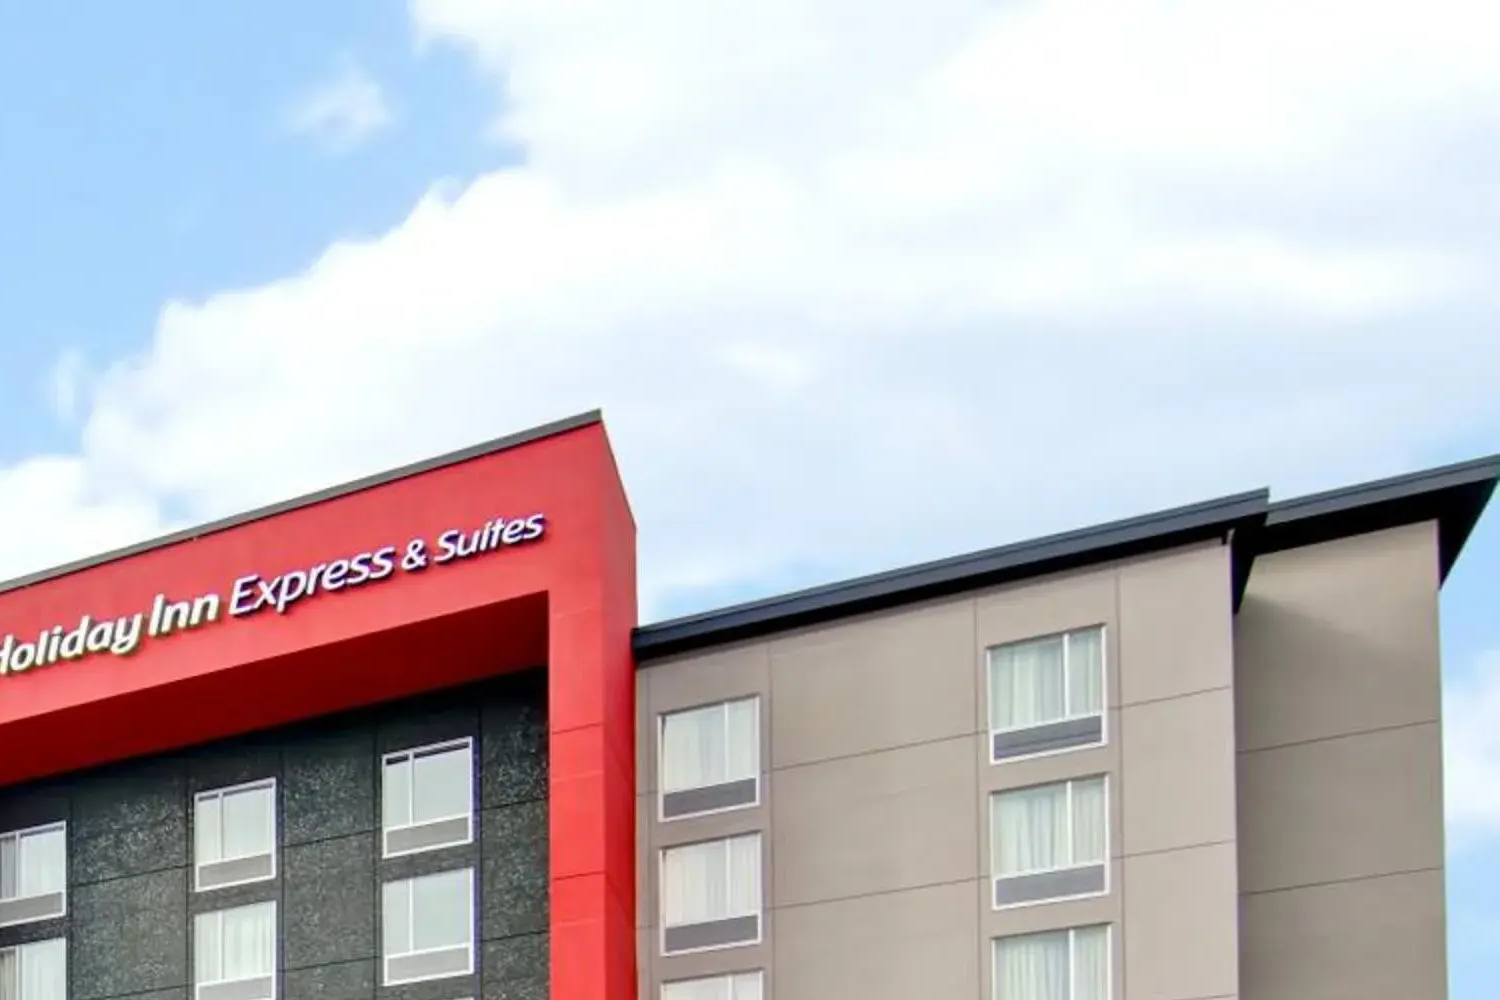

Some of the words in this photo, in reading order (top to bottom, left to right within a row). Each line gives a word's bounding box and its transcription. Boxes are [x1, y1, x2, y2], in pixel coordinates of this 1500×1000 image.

[148, 593, 220, 636] Inn
[227, 545, 397, 614] Express
[401, 538, 428, 571] &
[433, 512, 545, 562] Suites
